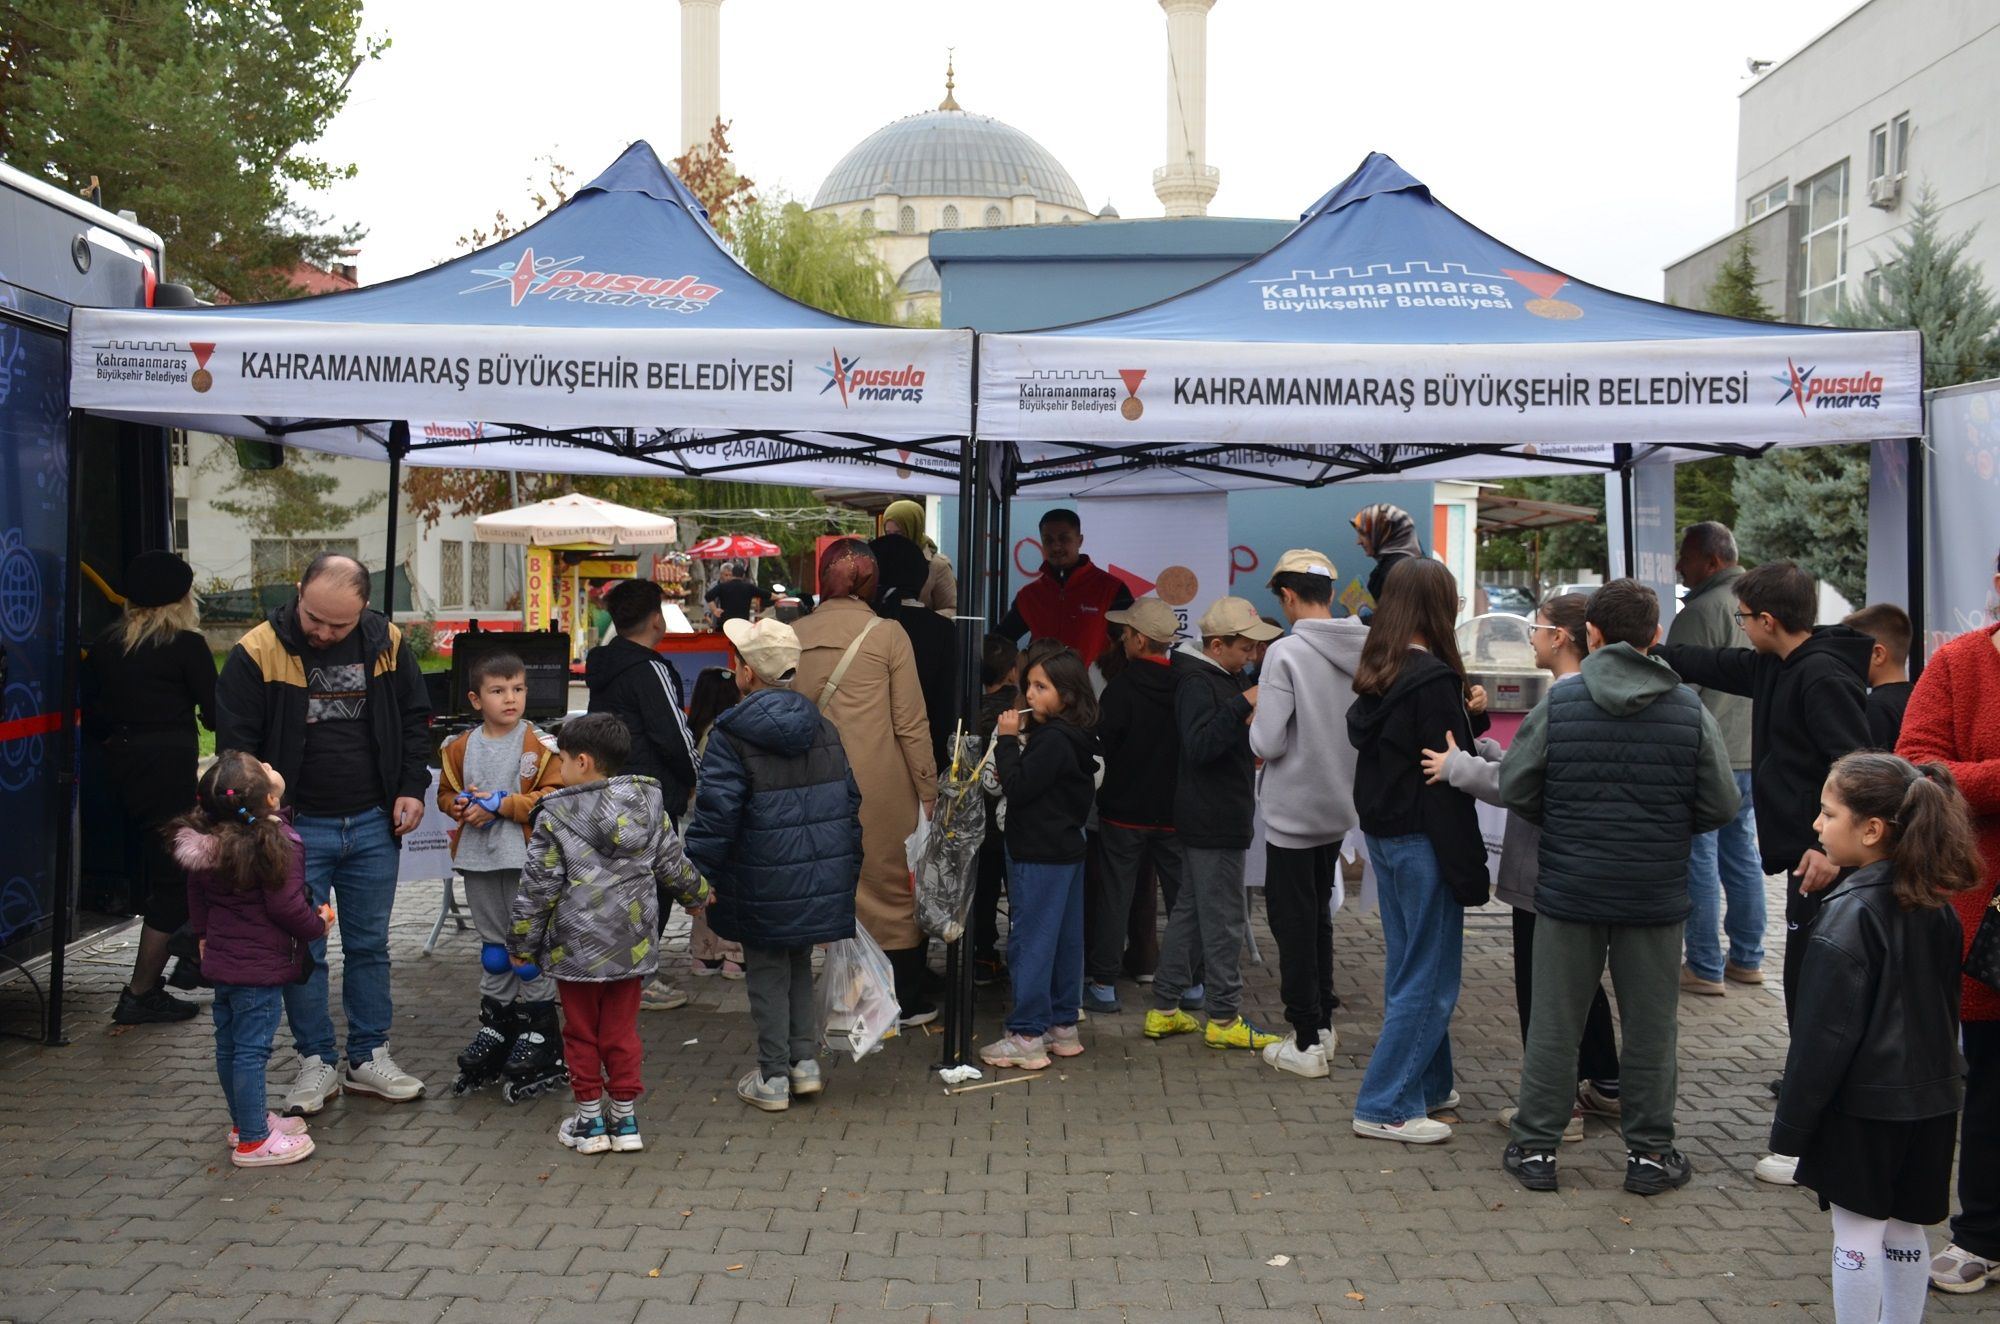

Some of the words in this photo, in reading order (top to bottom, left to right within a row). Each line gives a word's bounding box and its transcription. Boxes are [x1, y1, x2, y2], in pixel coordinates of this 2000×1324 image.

[529, 270, 723, 301] pusula
[1262, 281, 1506, 299] Kahramanmaraş
[549, 288, 709, 314] maraş
[1263, 297, 1389, 312] Büyükşehir
[1397, 294, 1513, 310] Belediyesi
[96, 352, 187, 371] Kahramanmaraş
[97, 368, 142, 382] Büyükşehir
[145, 370, 188, 384] Belediyesi
[241, 351, 470, 391] KAHRAMANMARAŞ
[478, 353, 638, 394] BÜYÜKŞEHİR
[647, 357, 794, 392] BELEDİYESİ
[848, 364, 926, 393] pusula
[858, 387, 924, 404] maraş
[1020, 383, 1117, 399] Kahramanmaraş
[1174, 377, 1415, 413] KAHRAMANMARAŞ
[1424, 373, 1591, 413] BÜYÜKŞEHİR
[1599, 370, 1749, 406] BELEDİYESİ
[1805, 371, 1884, 402] pusula
[1019, 399, 1069, 413] Büyükşehir
[1071, 400, 1117, 414] Belediyesi
[1815, 394, 1882, 410] maraş
[556, 527, 607, 537] GELATERIA
